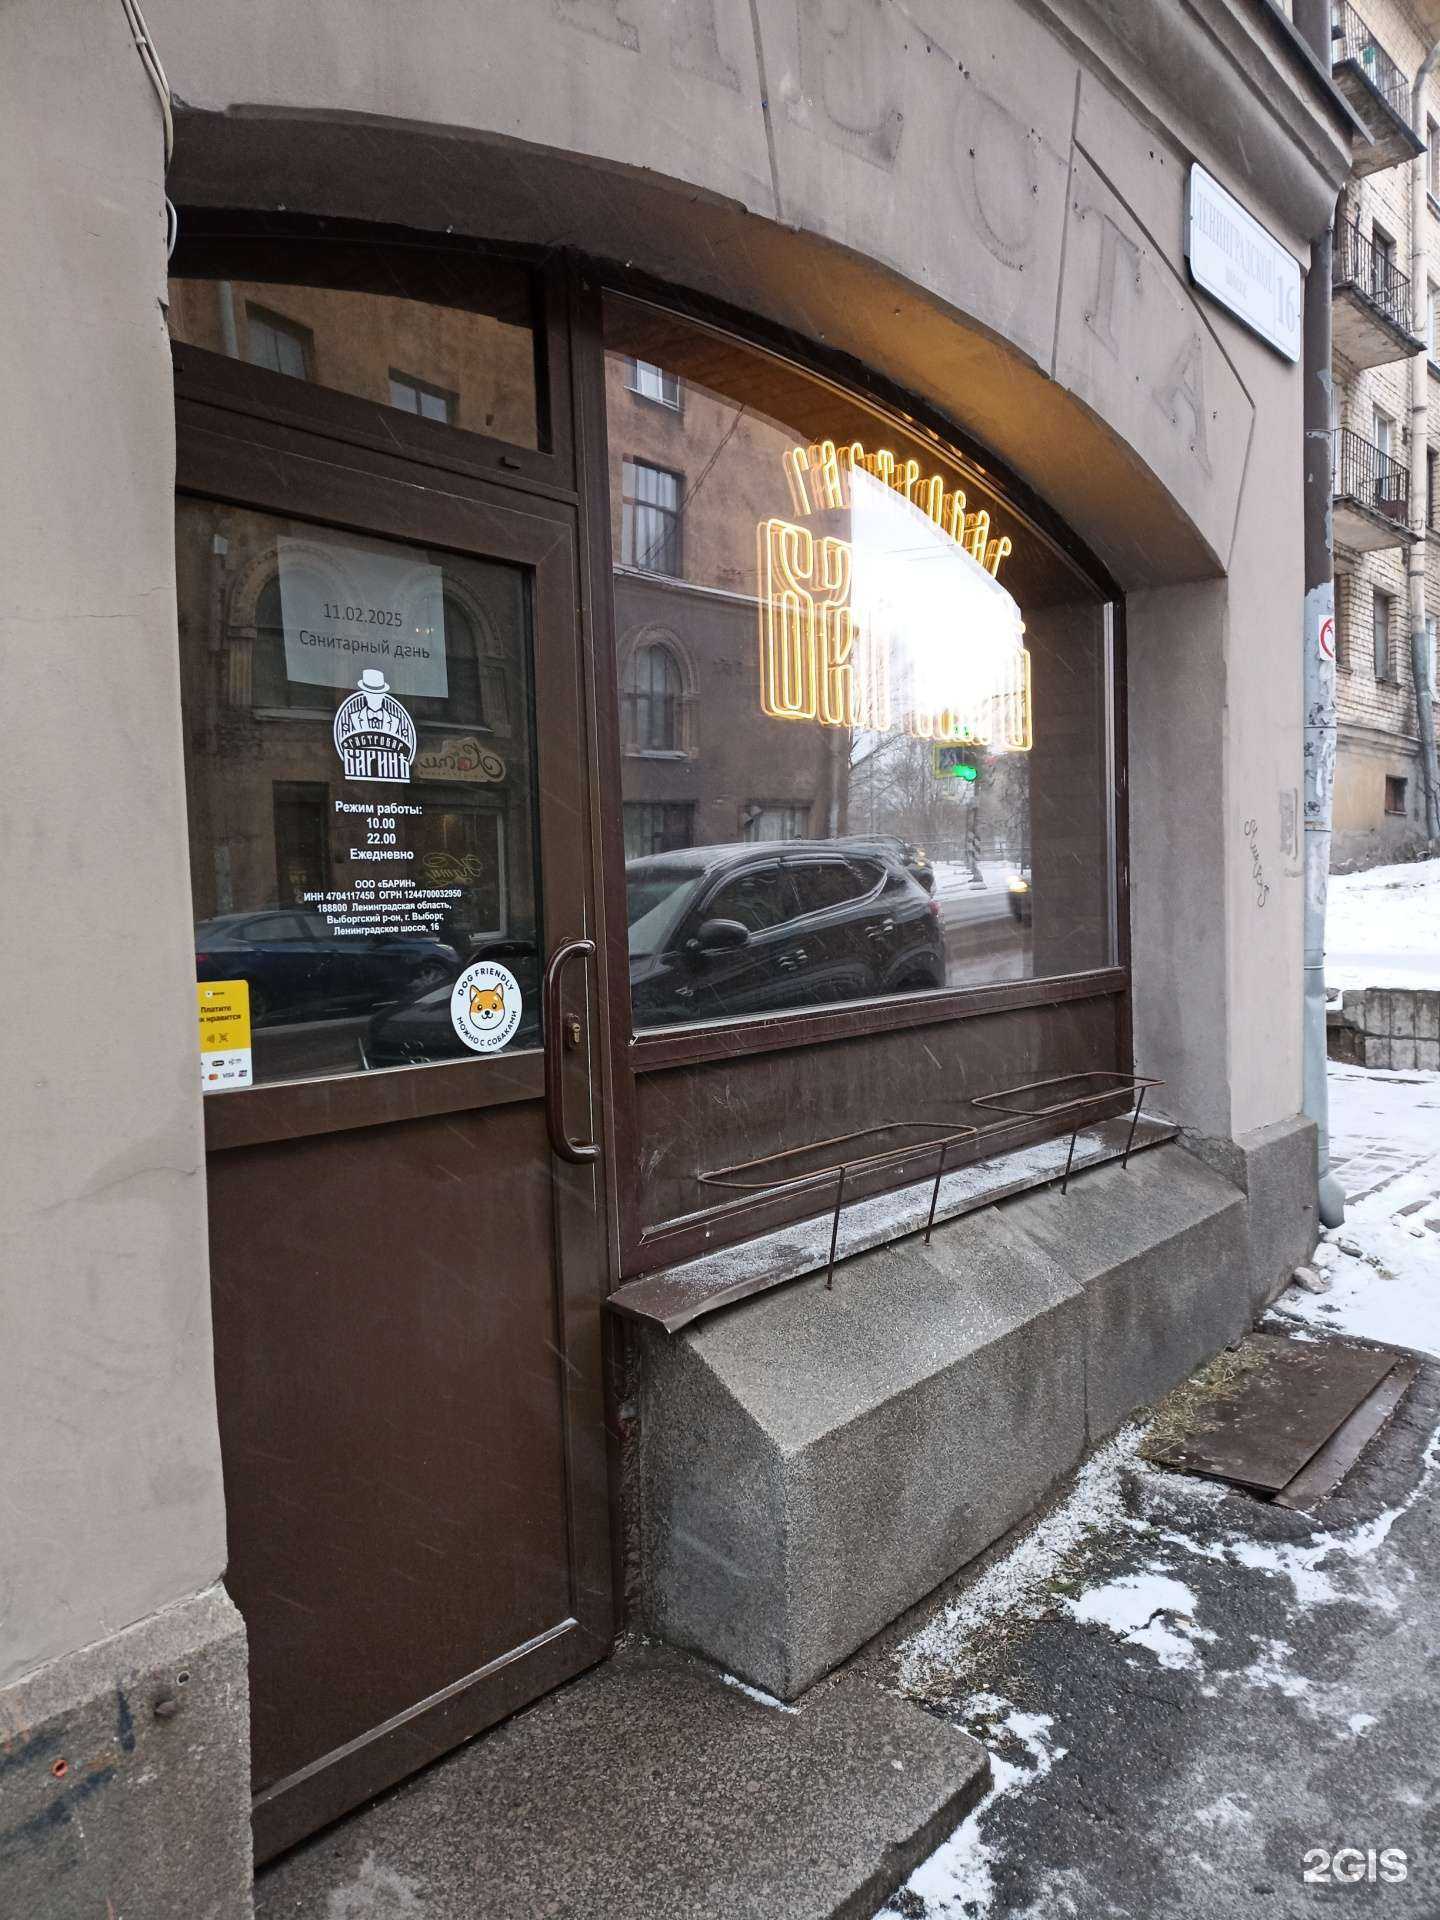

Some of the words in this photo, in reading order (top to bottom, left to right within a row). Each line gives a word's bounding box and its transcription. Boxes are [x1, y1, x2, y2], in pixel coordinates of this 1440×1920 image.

[1277, 275, 1296, 332] 16
[322, 603, 403, 627] 11.02.2025
[299, 630, 390, 655] Санитарный
[393, 645, 431, 659] день
[335, 800, 374, 813] Режим
[377, 803, 423, 816] работы:
[366, 818, 396, 829] 10.00
[367, 833, 396, 845] 22.00
[350, 848, 414, 861] Ежедневно
[354, 879, 376, 889] ООО
[377, 879, 416, 888] «БАРИН»
[303, 892, 324, 902] ИНН
[326, 891, 375, 901] 4704117450
[379, 890, 402, 899] ОГРН
[404, 889, 462, 899] 1244700032950
[317, 903, 348, 913] 188800
[351, 902, 416, 912] Ленинградская
[416, 900, 452, 910] область,
[326, 914, 381, 925] Выборгский
[382, 914, 403, 924] р-он,
[411, 911, 445, 922] Выборг,
[333, 926, 399, 936] Ленинградское
[400, 923, 429, 933] шоссе,
[430, 922, 440, 931] 16
[457, 974, 474, 997] DOG
[474, 967, 515, 991] FRIENDLY
[456, 1016, 480, 1045] МОЖНО
[487, 1010, 518, 1046] СОБАКАМИ
